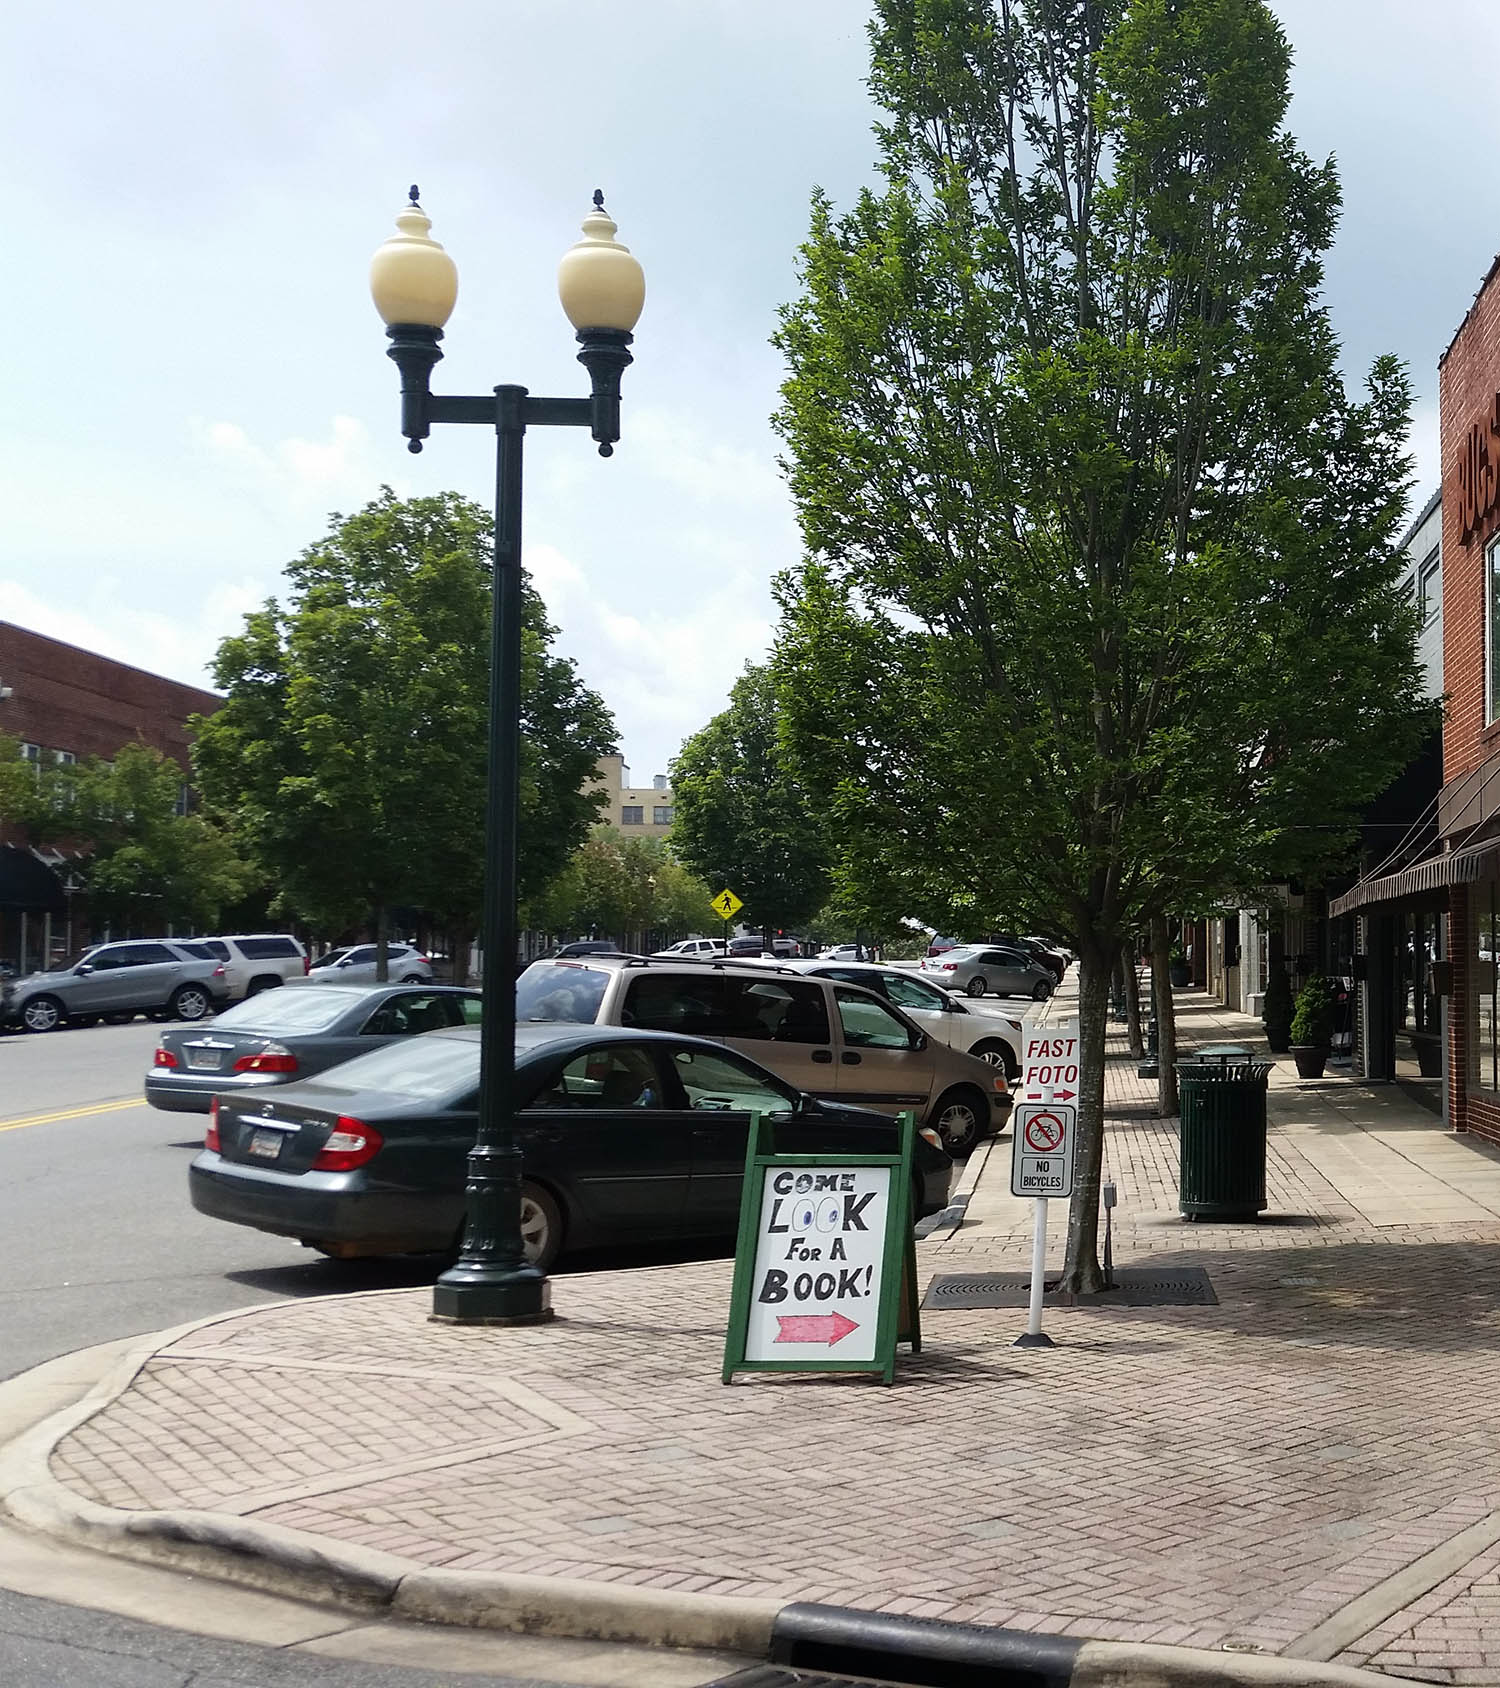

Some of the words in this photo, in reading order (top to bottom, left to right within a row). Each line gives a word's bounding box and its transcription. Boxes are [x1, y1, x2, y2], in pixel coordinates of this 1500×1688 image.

[1027, 1039, 1077, 1058] FAST
[1026, 1065, 1078, 1084] FOTO
[1036, 1161, 1050, 1173] NO
[773, 1172, 856, 1195] COME
[1023, 1176, 1061, 1188] BICYCLES
[768, 1192, 878, 1234] LOOK
[830, 1237, 847, 1261] A
[758, 1264, 873, 1304] BOOK!
